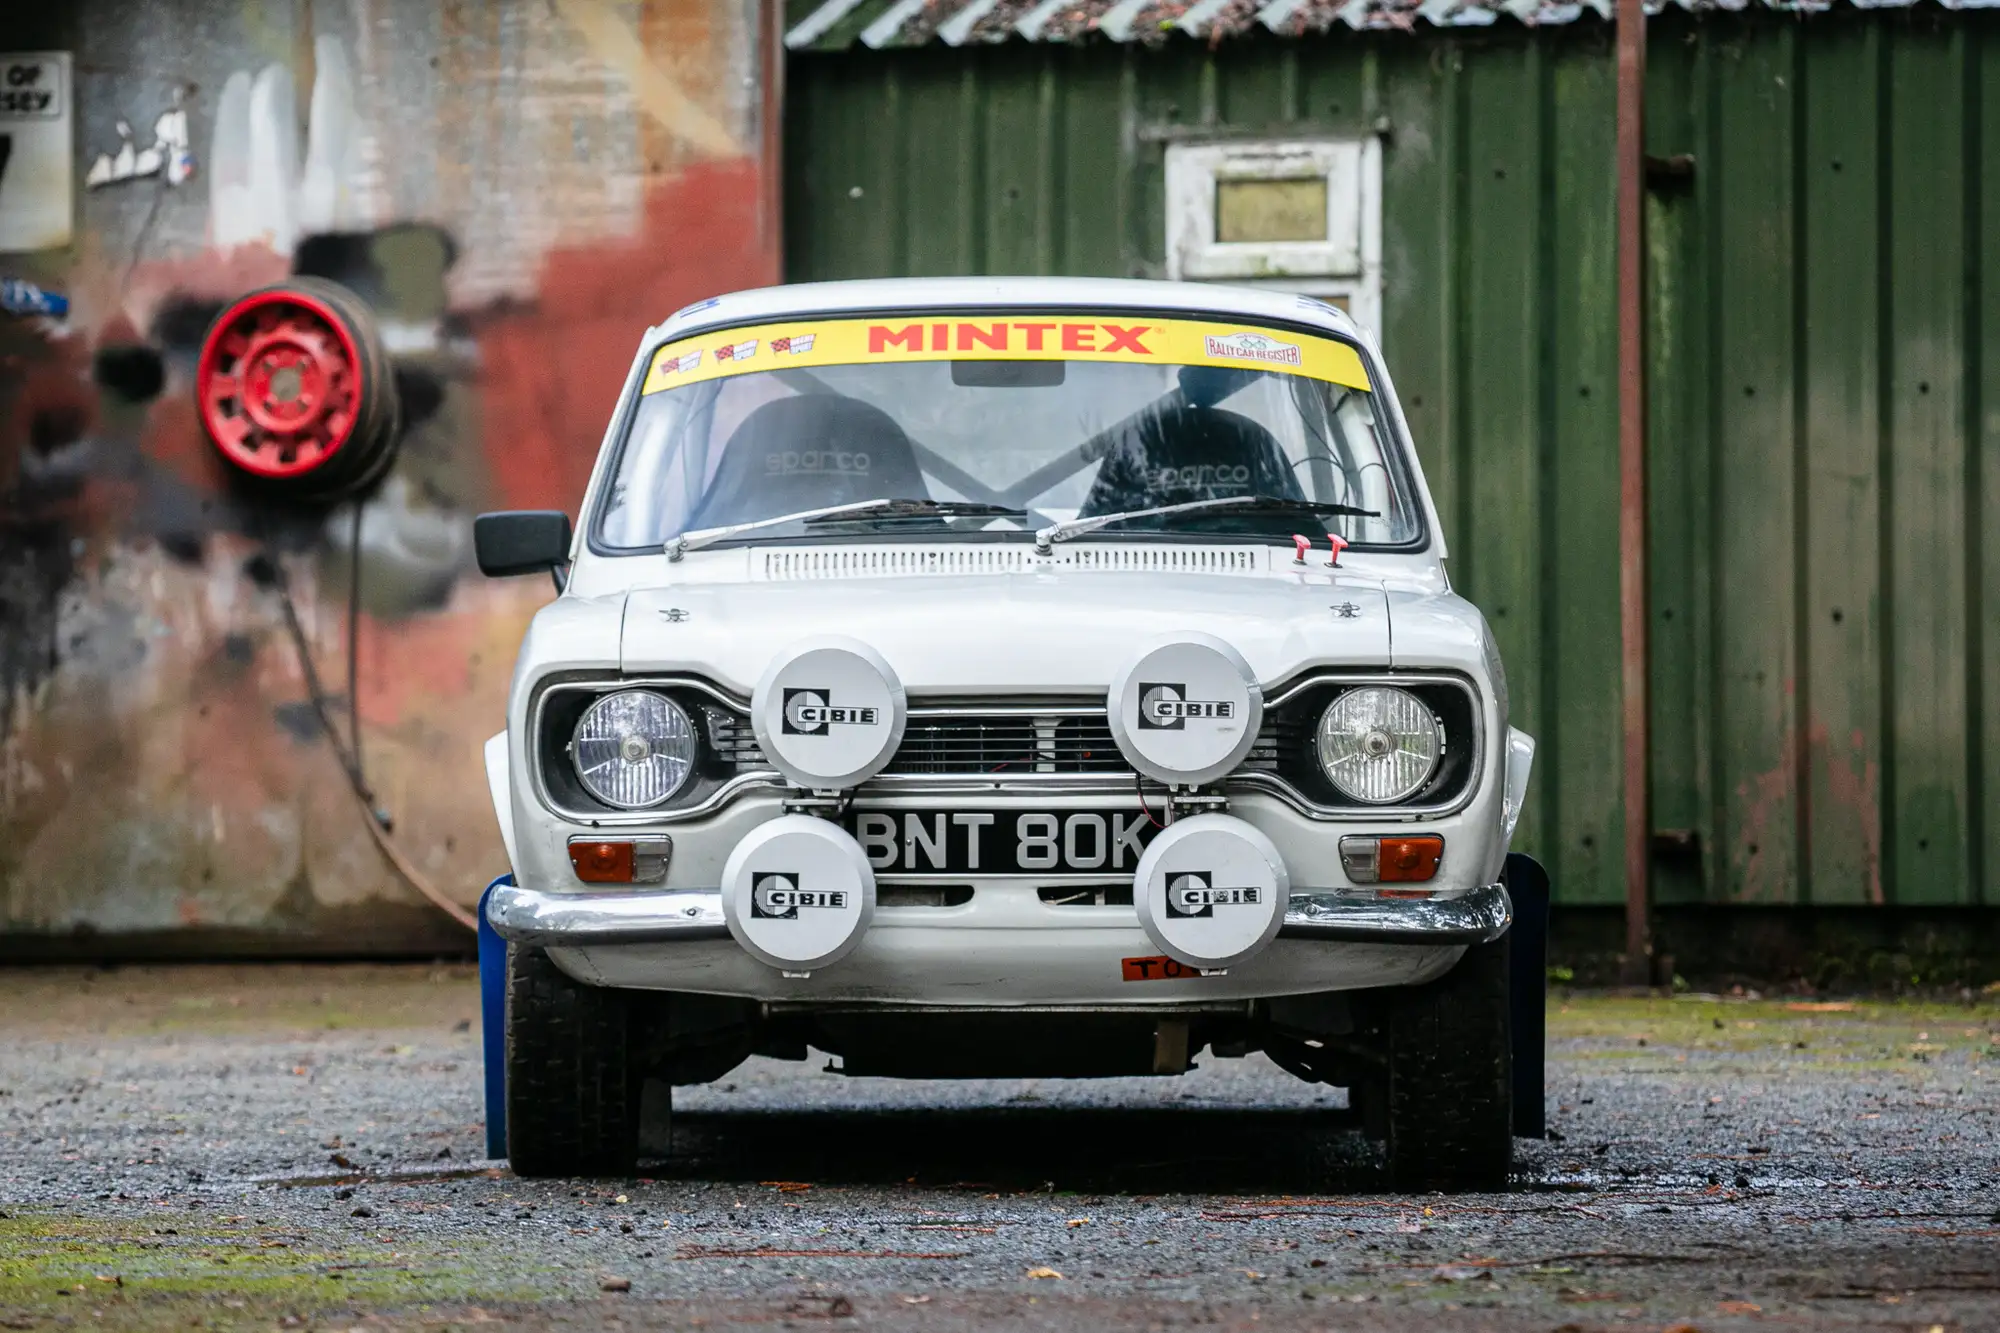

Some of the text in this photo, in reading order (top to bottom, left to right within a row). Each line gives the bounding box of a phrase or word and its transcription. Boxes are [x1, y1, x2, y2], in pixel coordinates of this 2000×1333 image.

[868, 323, 1154, 354] MINTEX
[1209, 338, 1235, 356] RALLY
[1236, 347, 1255, 358] CAR
[1256, 346, 1299, 364] REGISTER
[765, 450, 871, 473] sparco
[857, 813, 1150, 869] BNT 80K
[1129, 959, 1200, 978] TO
